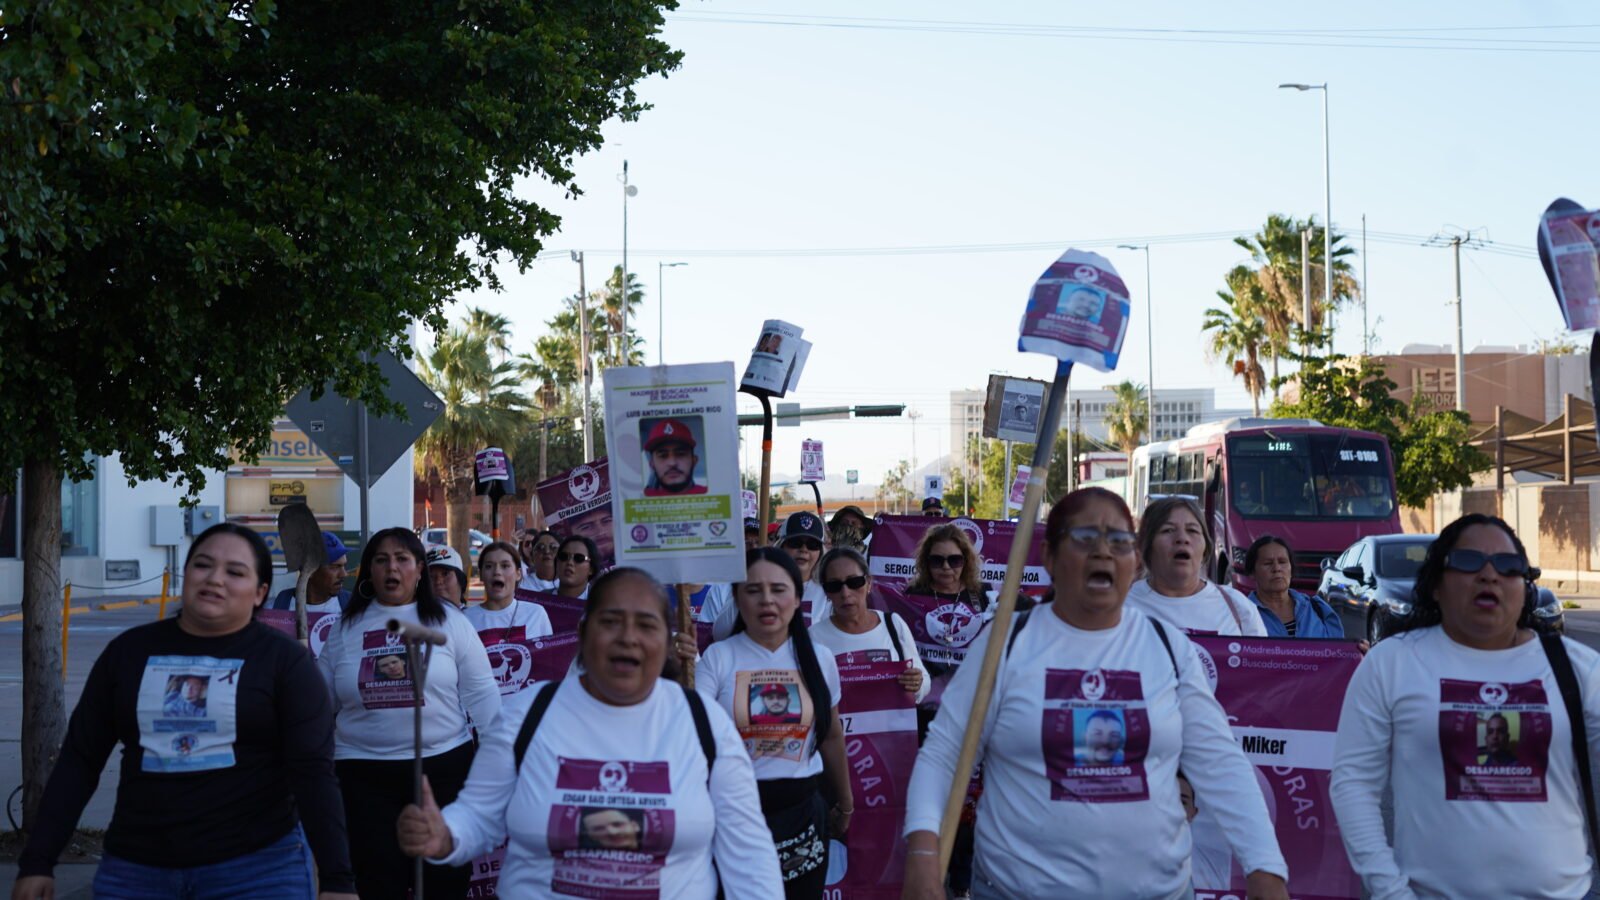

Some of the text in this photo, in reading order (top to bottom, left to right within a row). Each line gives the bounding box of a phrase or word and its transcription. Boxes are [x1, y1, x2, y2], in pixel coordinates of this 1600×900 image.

[660, 386, 708, 395] BUSCADORAS
[642, 409, 670, 417] ANTONIO
[672, 407, 704, 415] ARELLANO
[1242, 736, 1287, 755] Miker
[1066, 766, 1132, 776] DESAPARECIDO
[1464, 766, 1532, 776] DESAPARECIDO
[562, 793, 586, 803] EDGAR
[607, 795, 636, 805] ORTEGA
[564, 850, 654, 863] DESAPARECIDO
